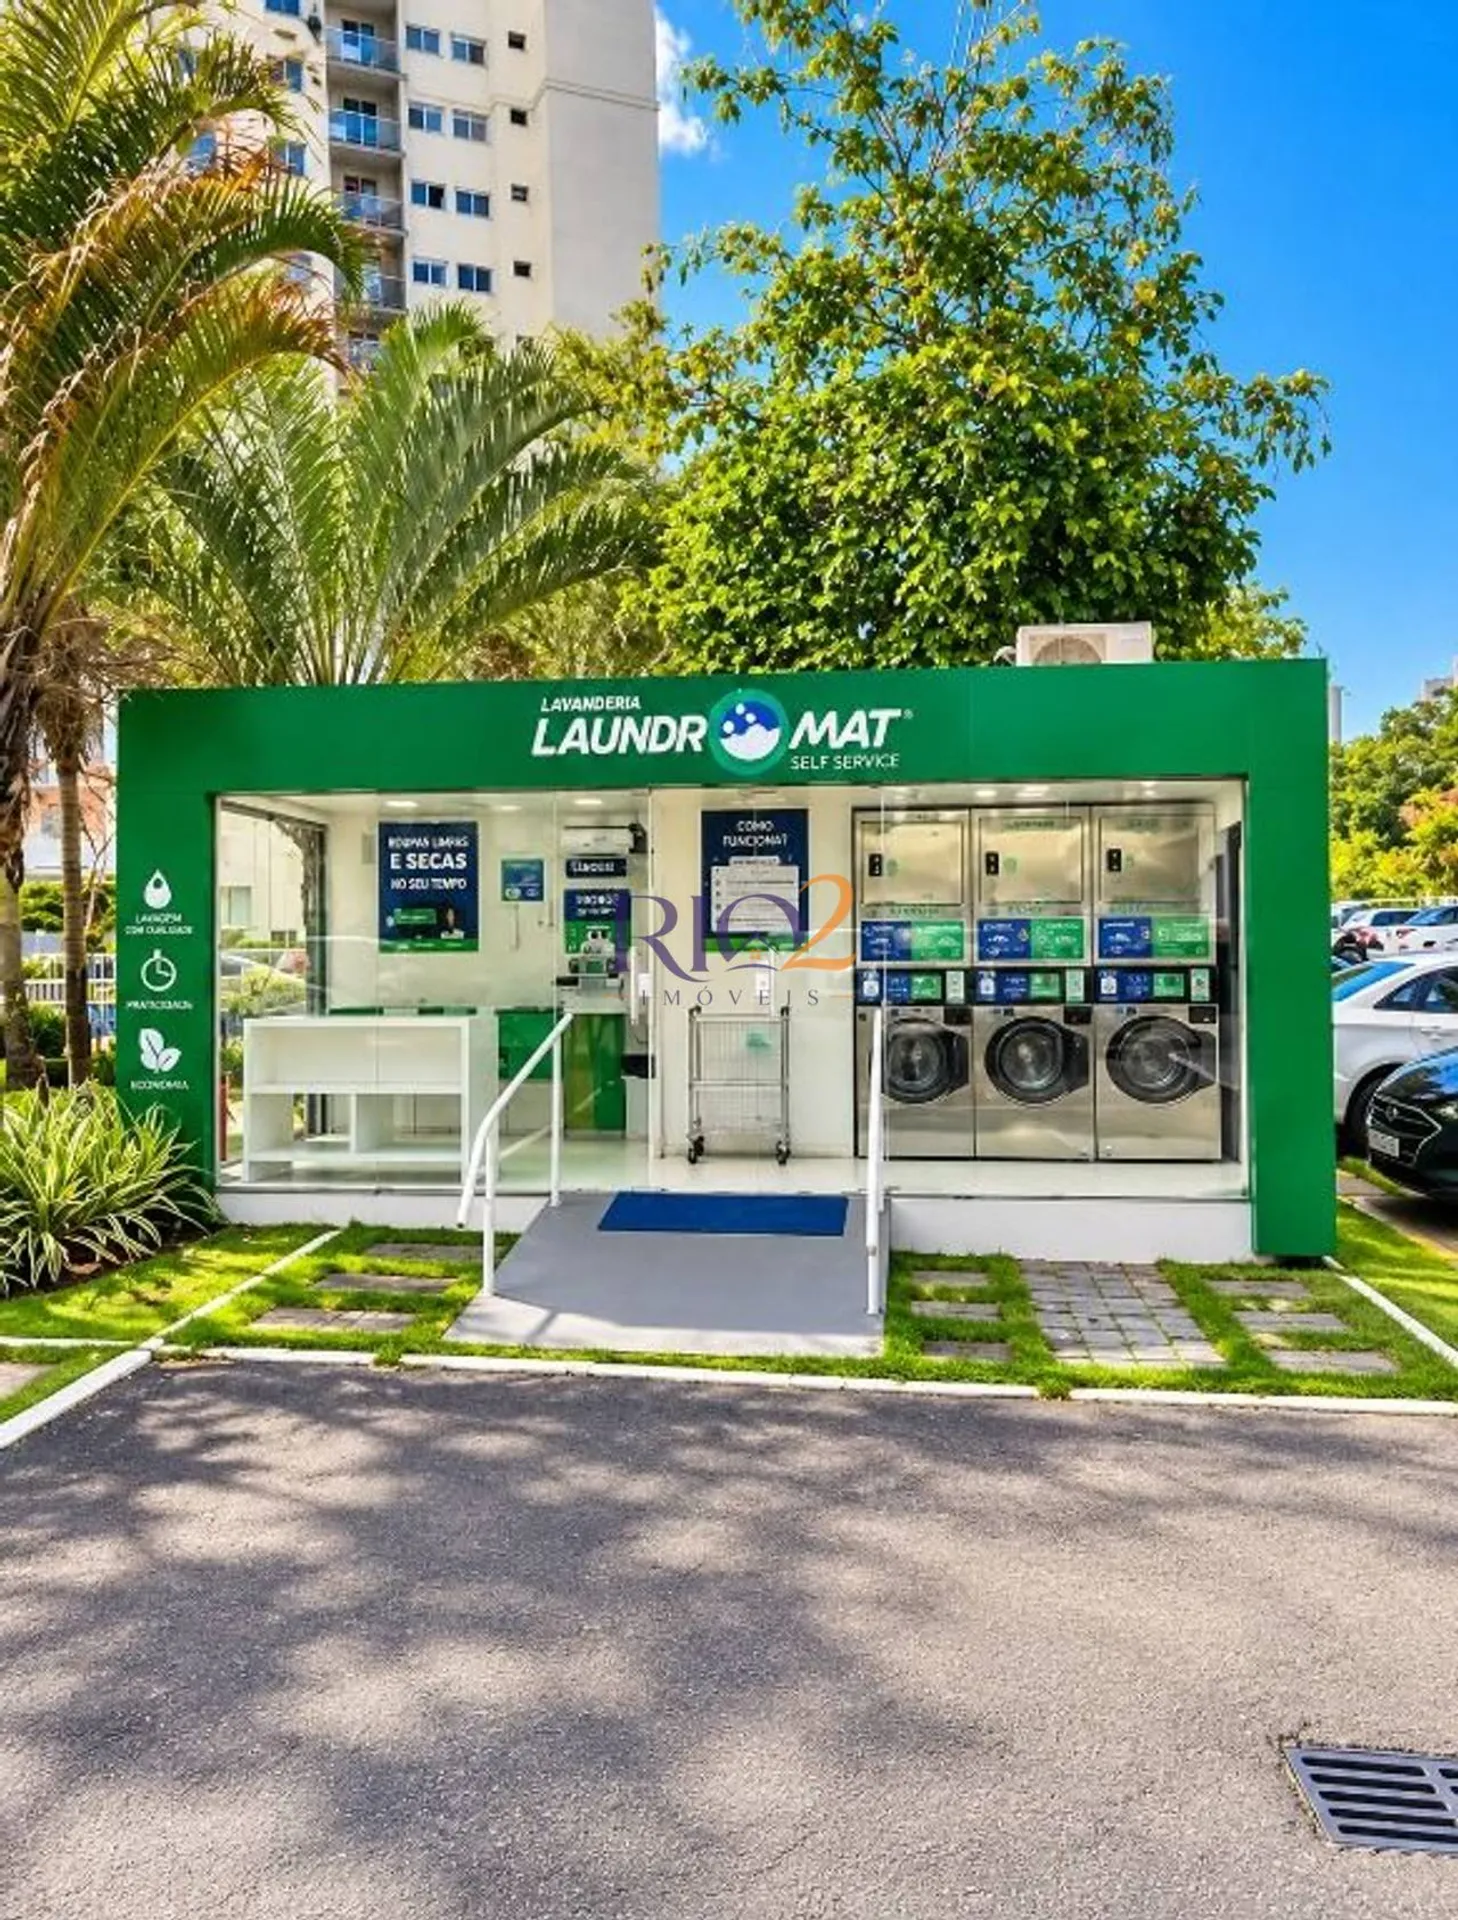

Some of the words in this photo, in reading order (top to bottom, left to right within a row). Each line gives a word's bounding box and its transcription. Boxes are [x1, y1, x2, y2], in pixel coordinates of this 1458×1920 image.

[540, 695, 641, 713] LAVANDERIA
[790, 755, 830, 770] SELF
[833, 752, 900, 770] SERVICE
[390, 852, 402, 870] E
[405, 852, 468, 870] SECAS
